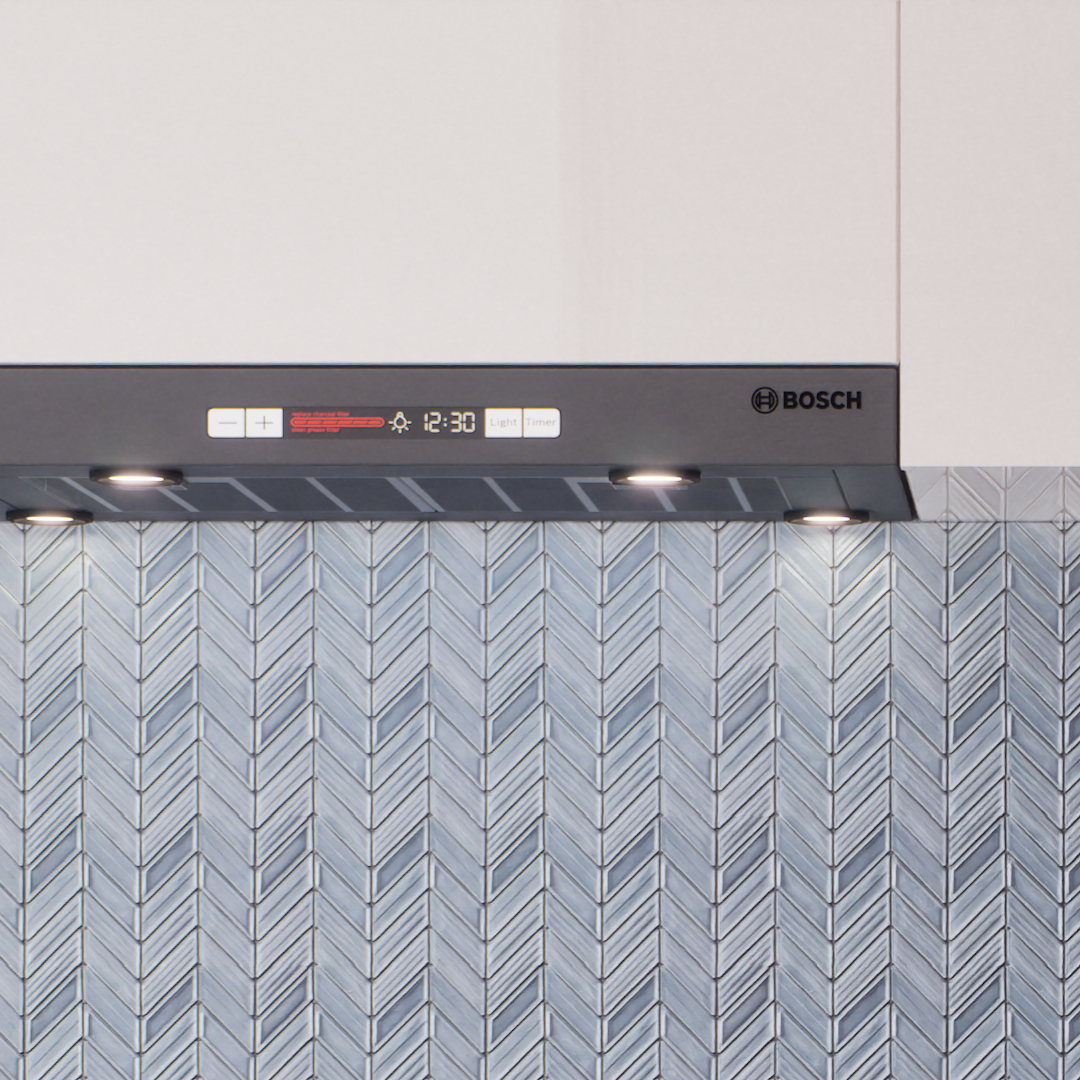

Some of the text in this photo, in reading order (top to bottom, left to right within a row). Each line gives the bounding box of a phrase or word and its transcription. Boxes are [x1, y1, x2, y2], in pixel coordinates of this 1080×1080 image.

[783, 391, 862, 410] BOSCH
[423, 412, 476, 433] 12:30
[490, 418, 518, 428] Light
[525, 418, 557, 427] Timer
